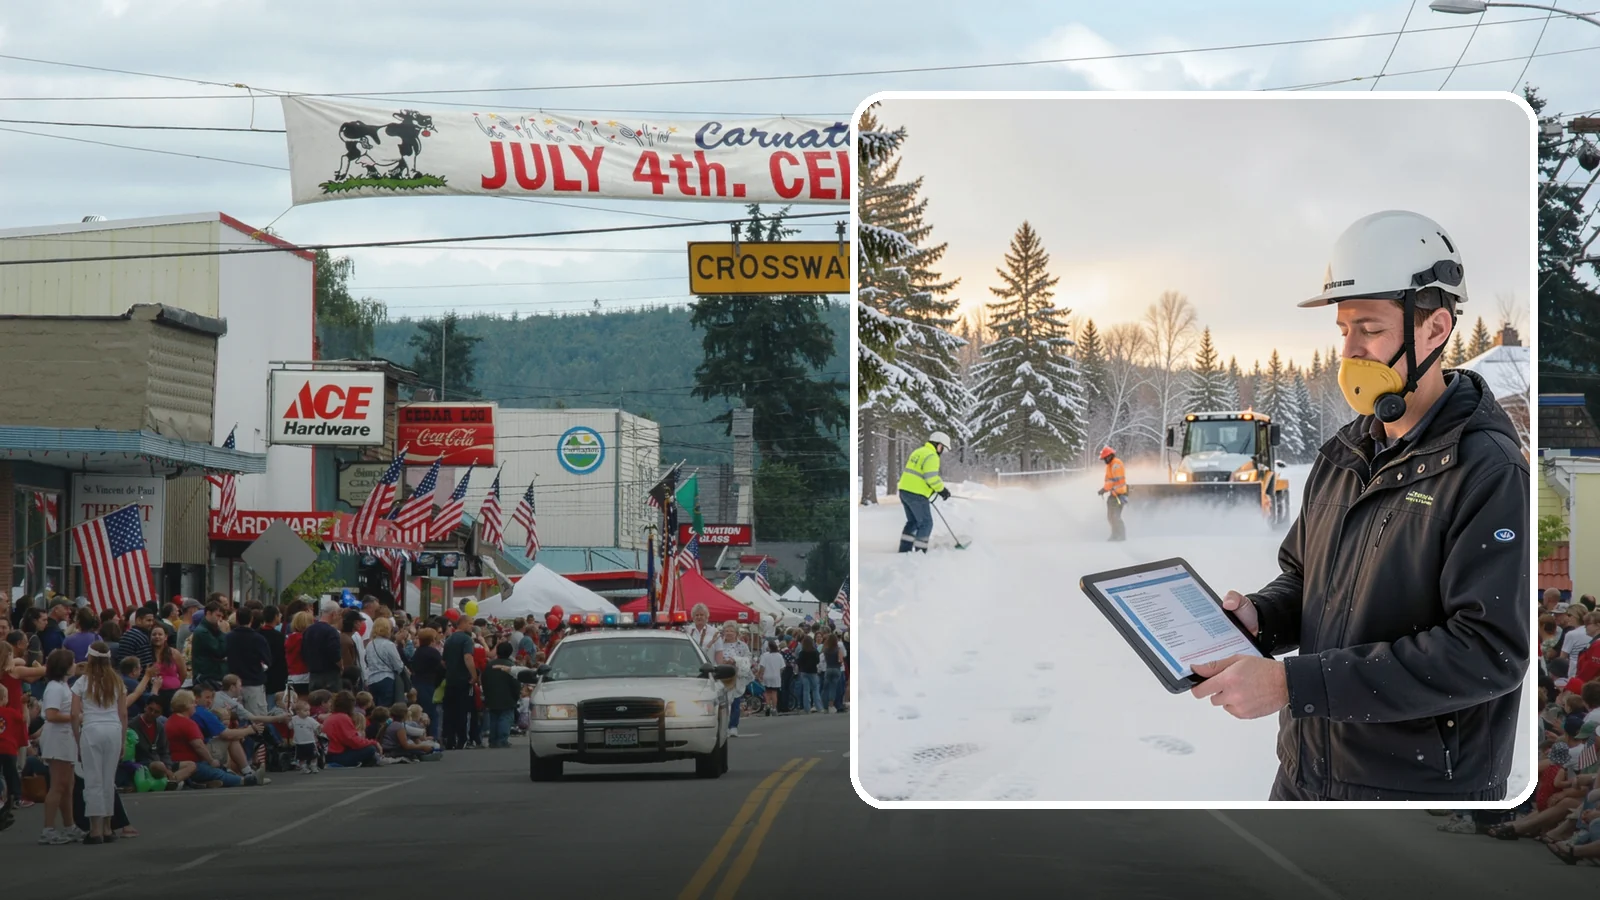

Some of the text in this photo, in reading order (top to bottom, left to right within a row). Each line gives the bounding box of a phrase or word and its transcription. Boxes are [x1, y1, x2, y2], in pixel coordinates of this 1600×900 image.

[695, 121, 850, 149] Carnat
[481, 141, 605, 192] JULY
[632, 150, 746, 197] 4th.
[697, 254, 850, 280] CROSSWA
[283, 380, 373, 420] ACE
[406, 409, 452, 421] CEDAR
[283, 421, 371, 436] Hardware
[416, 428, 477, 447] Coca-Cola
[95, 484, 124, 495] Vincent
[126, 485, 136, 494] de
[137, 486, 155, 495] Paul
